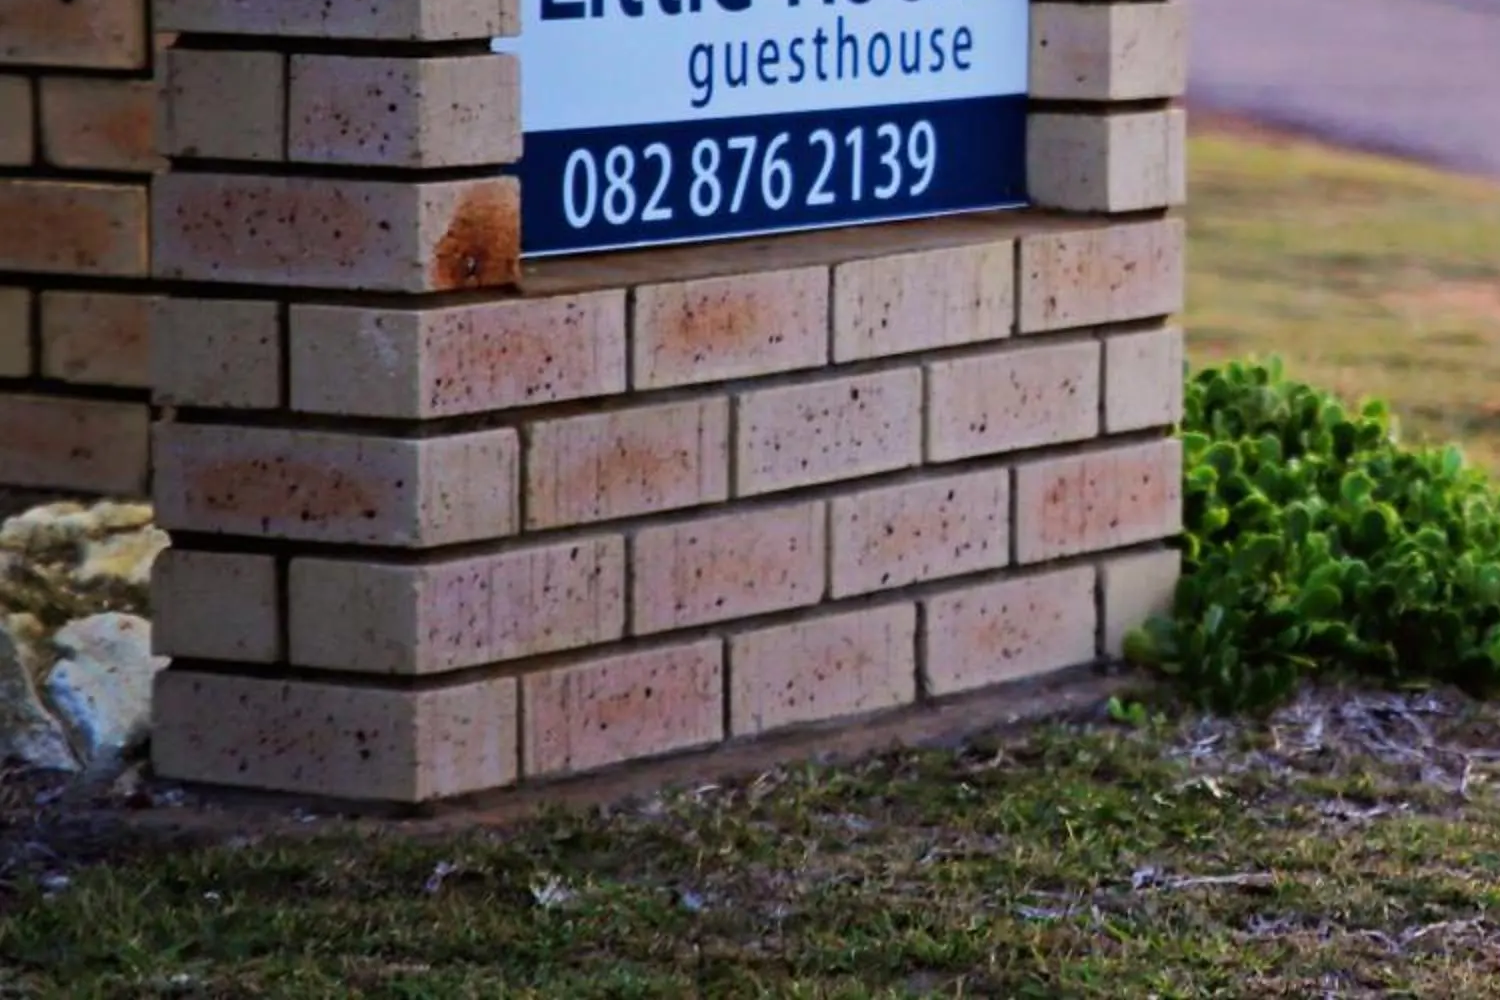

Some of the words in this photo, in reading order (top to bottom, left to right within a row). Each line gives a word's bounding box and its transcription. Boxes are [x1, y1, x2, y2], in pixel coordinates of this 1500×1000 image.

[687, 15, 973, 107] guesthouse
[562, 142, 673, 229] 082
[689, 132, 793, 218] 876
[805, 120, 937, 206] 2139
